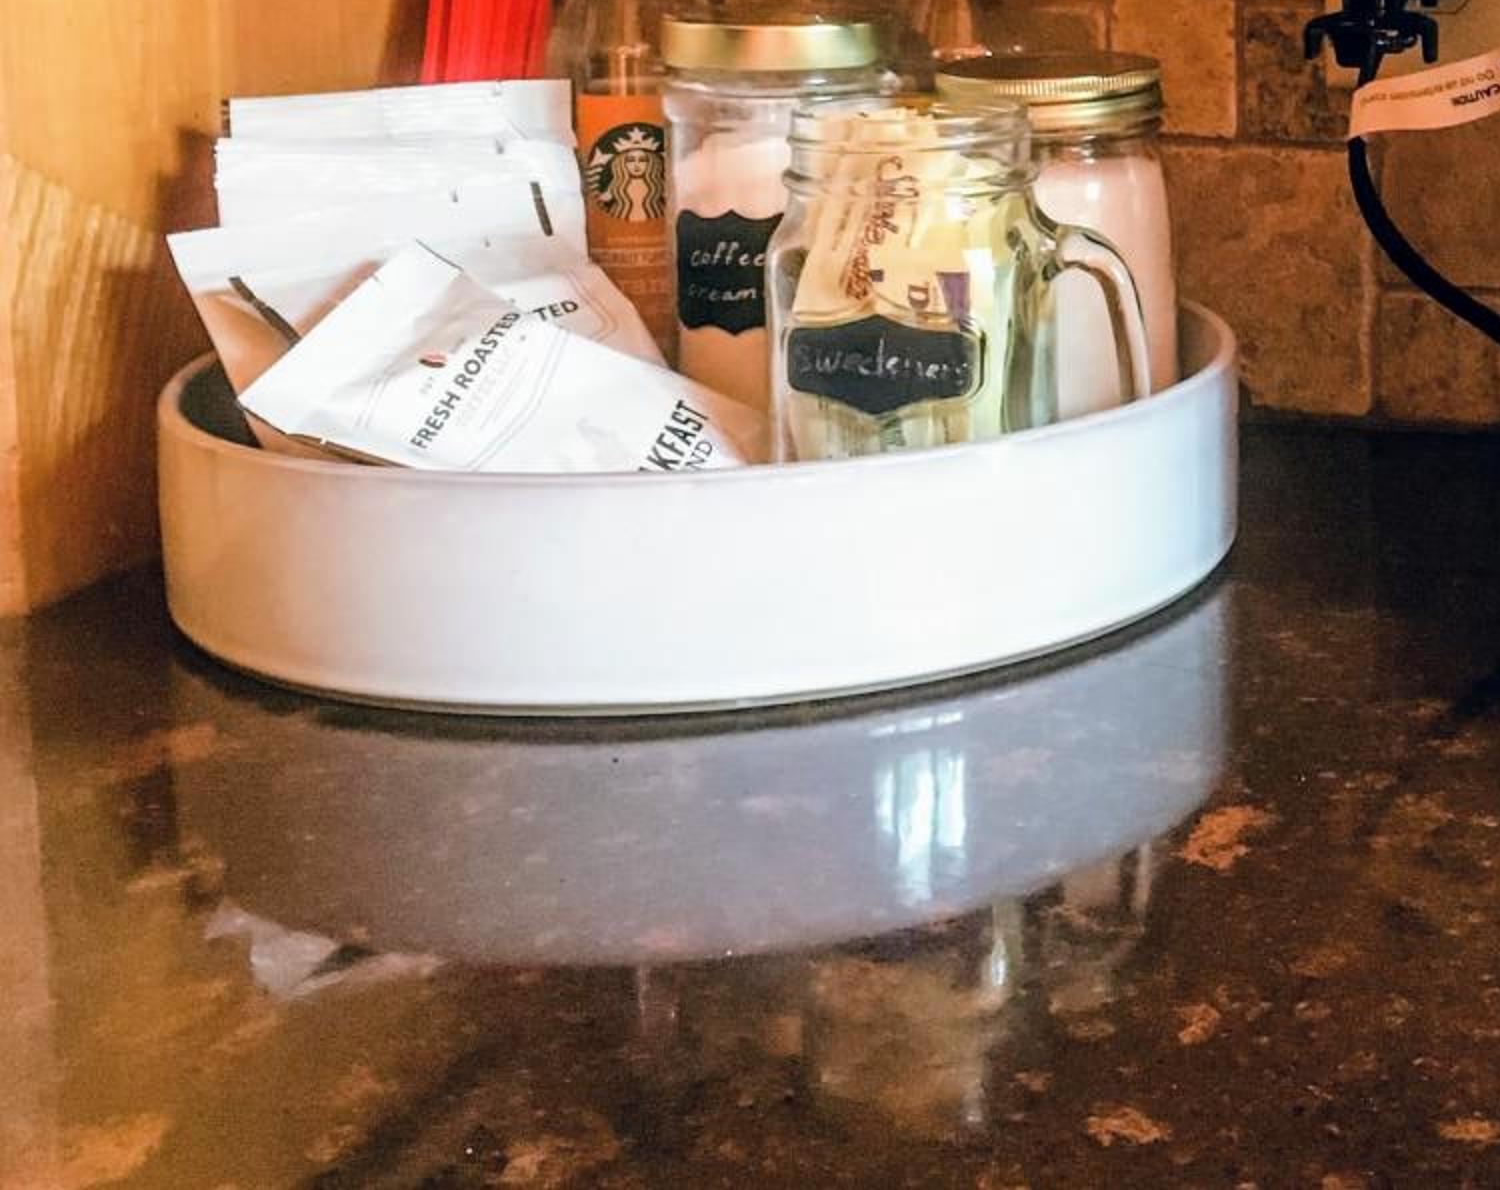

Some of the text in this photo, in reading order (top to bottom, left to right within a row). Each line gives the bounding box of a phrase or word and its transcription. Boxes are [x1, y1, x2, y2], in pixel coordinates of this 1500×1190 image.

[410, 311, 521, 449] FRESH ROASTED
[640, 399, 710, 472] KFAST
